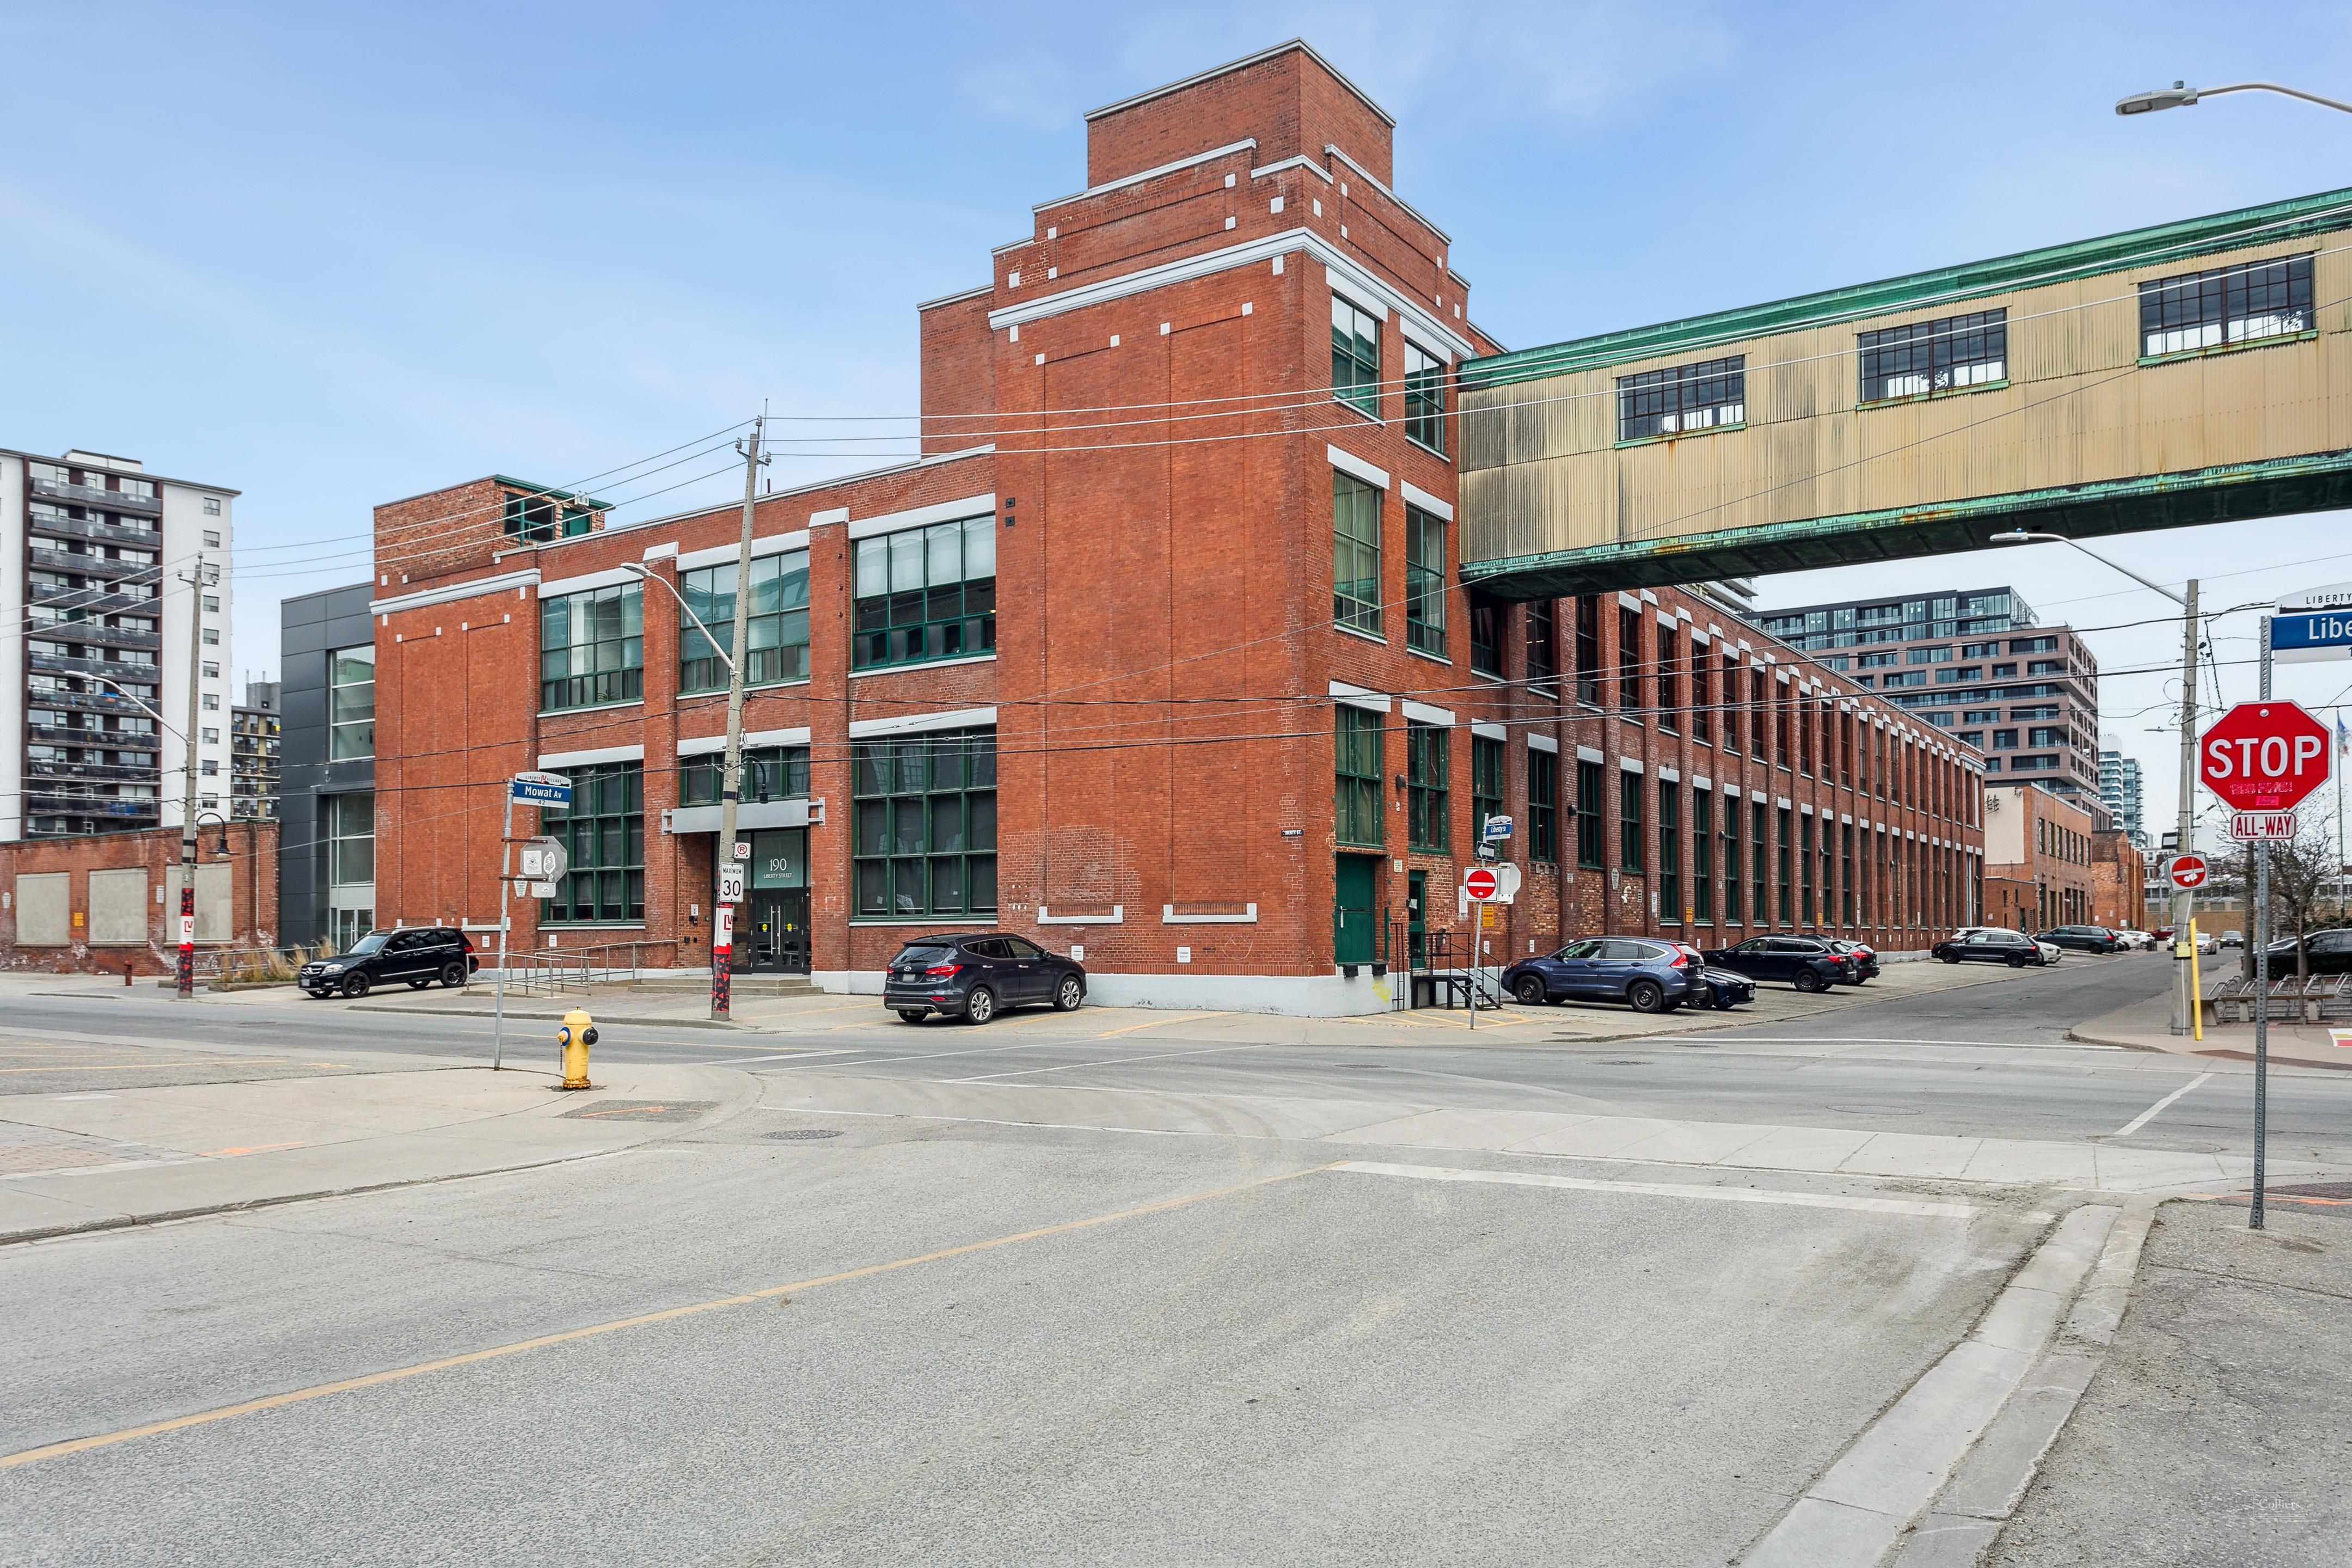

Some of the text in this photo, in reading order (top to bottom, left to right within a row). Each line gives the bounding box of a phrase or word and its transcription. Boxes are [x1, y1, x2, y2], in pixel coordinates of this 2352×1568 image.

[2306, 593, 2352, 604] LIBERTY
[2208, 736, 2321, 779] STOP
[525, 786, 552, 797] Mowat
[2235, 816, 2292, 836] ALL-WAY
[769, 858, 787, 871] 190
[723, 880, 741, 896] 30
